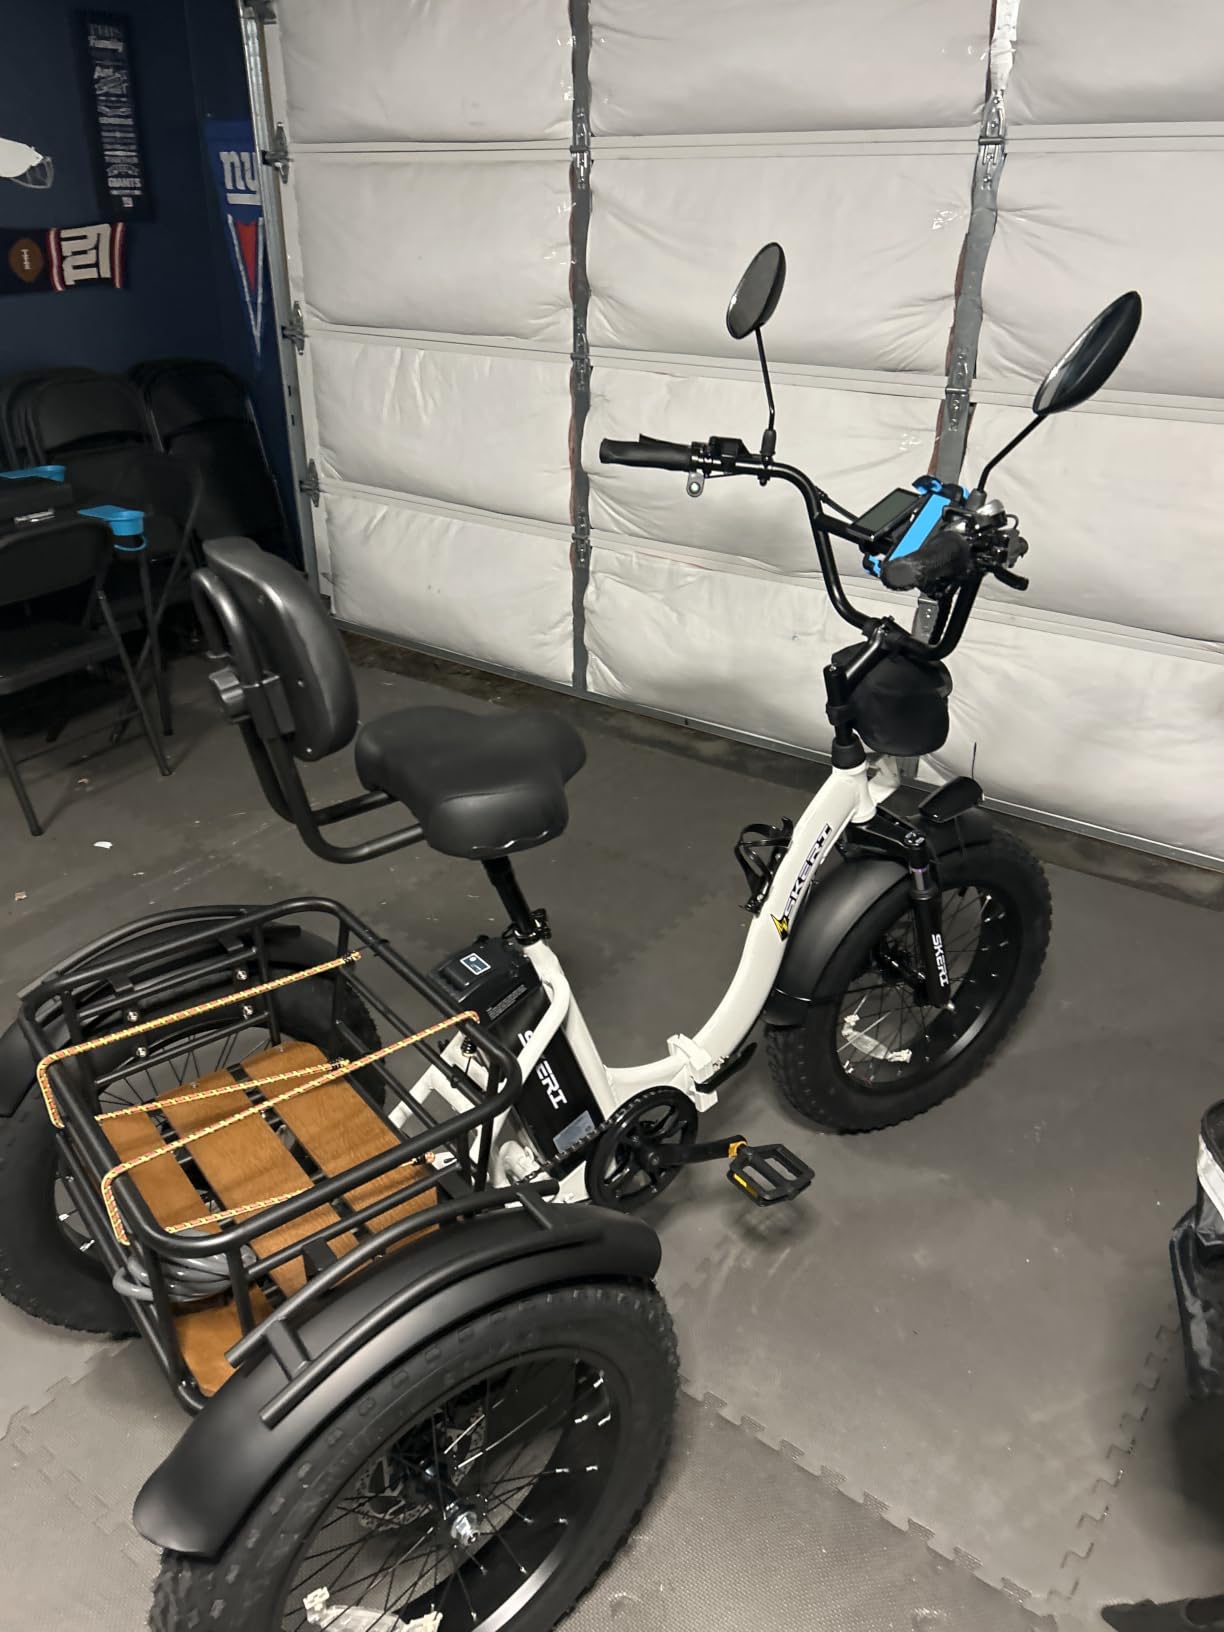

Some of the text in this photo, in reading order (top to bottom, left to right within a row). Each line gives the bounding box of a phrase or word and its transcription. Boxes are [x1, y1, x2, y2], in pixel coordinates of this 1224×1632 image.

[107, 177, 142, 188] GIANTS
[784, 823, 833, 918] SKERI
[931, 933, 949, 987] SKERI
[517, 1030, 568, 1109] SERI
